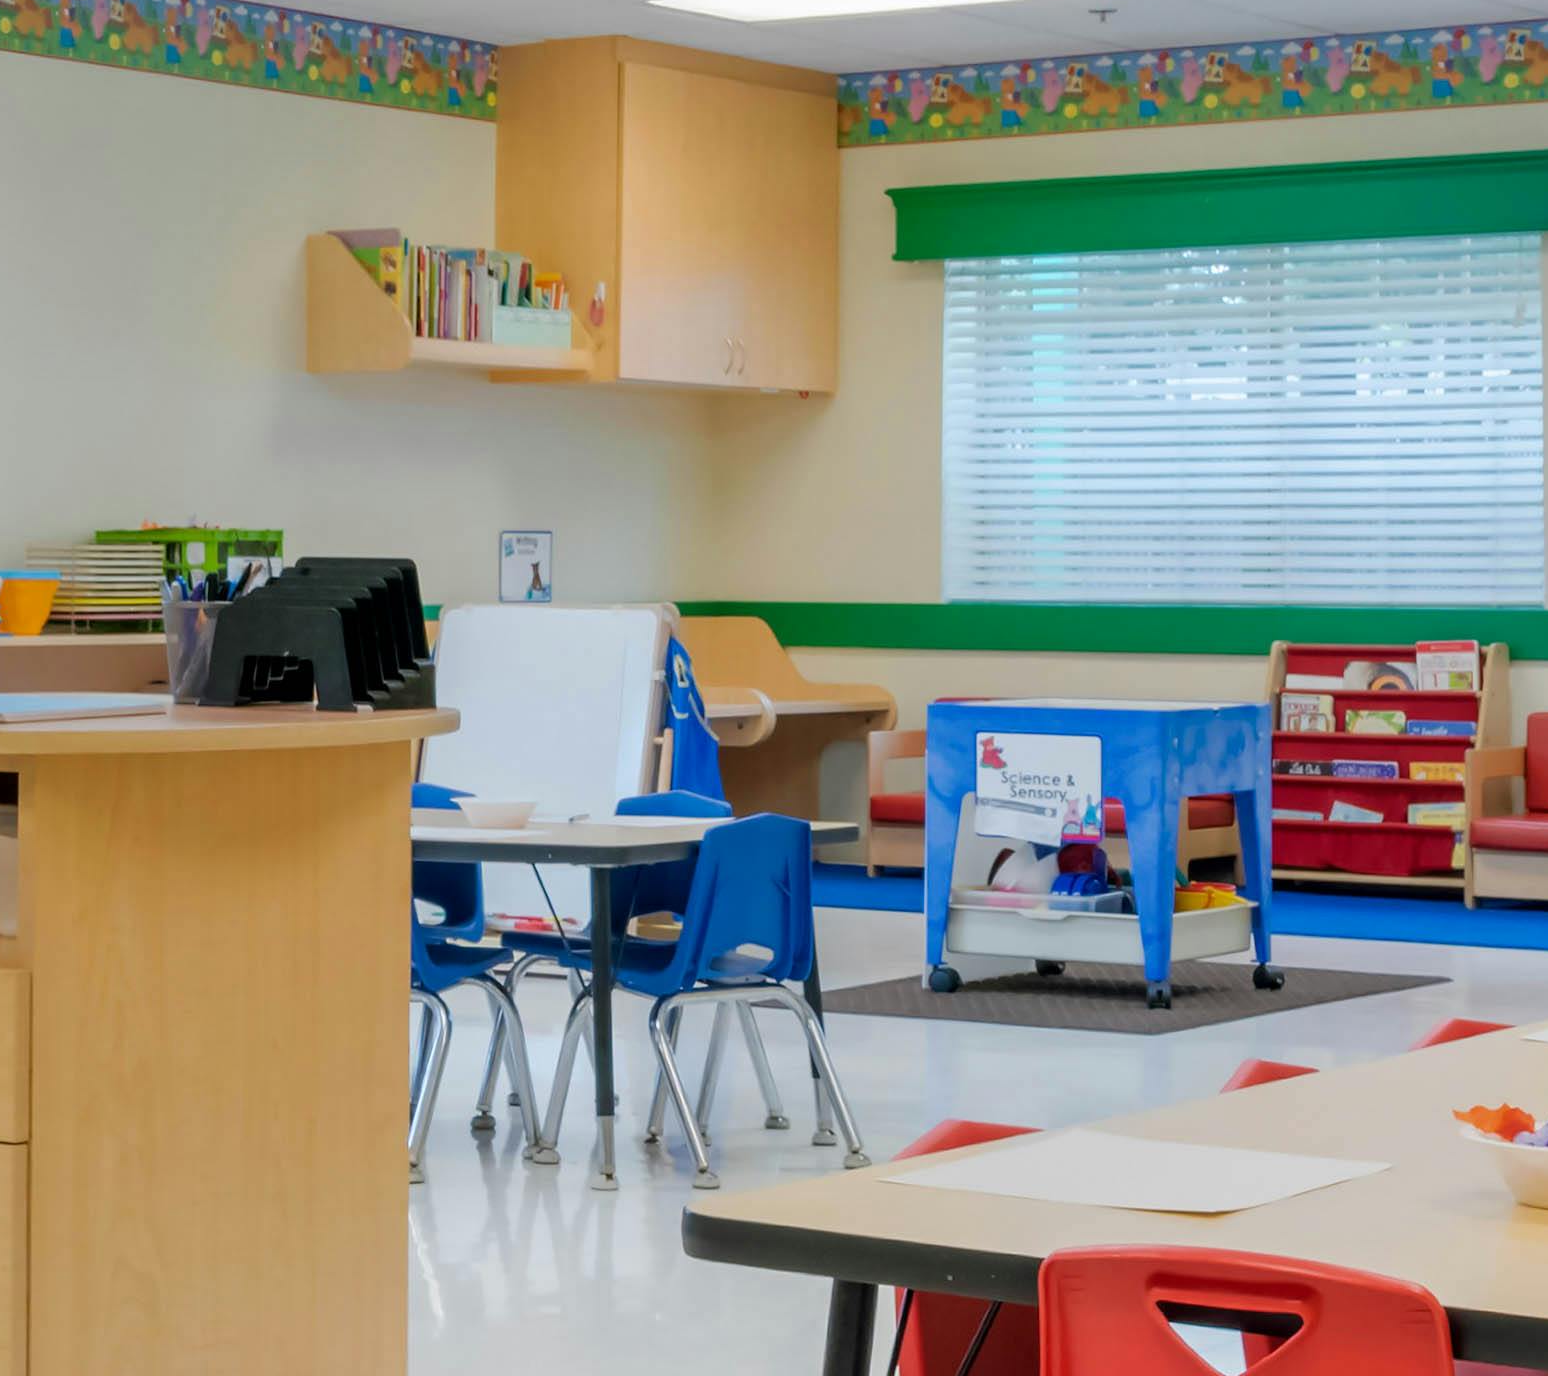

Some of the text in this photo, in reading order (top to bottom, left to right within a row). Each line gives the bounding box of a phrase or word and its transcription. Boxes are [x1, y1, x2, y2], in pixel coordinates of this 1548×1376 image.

[1000, 771, 1076, 787] Science &
[1009, 785, 1068, 802] Sensory
